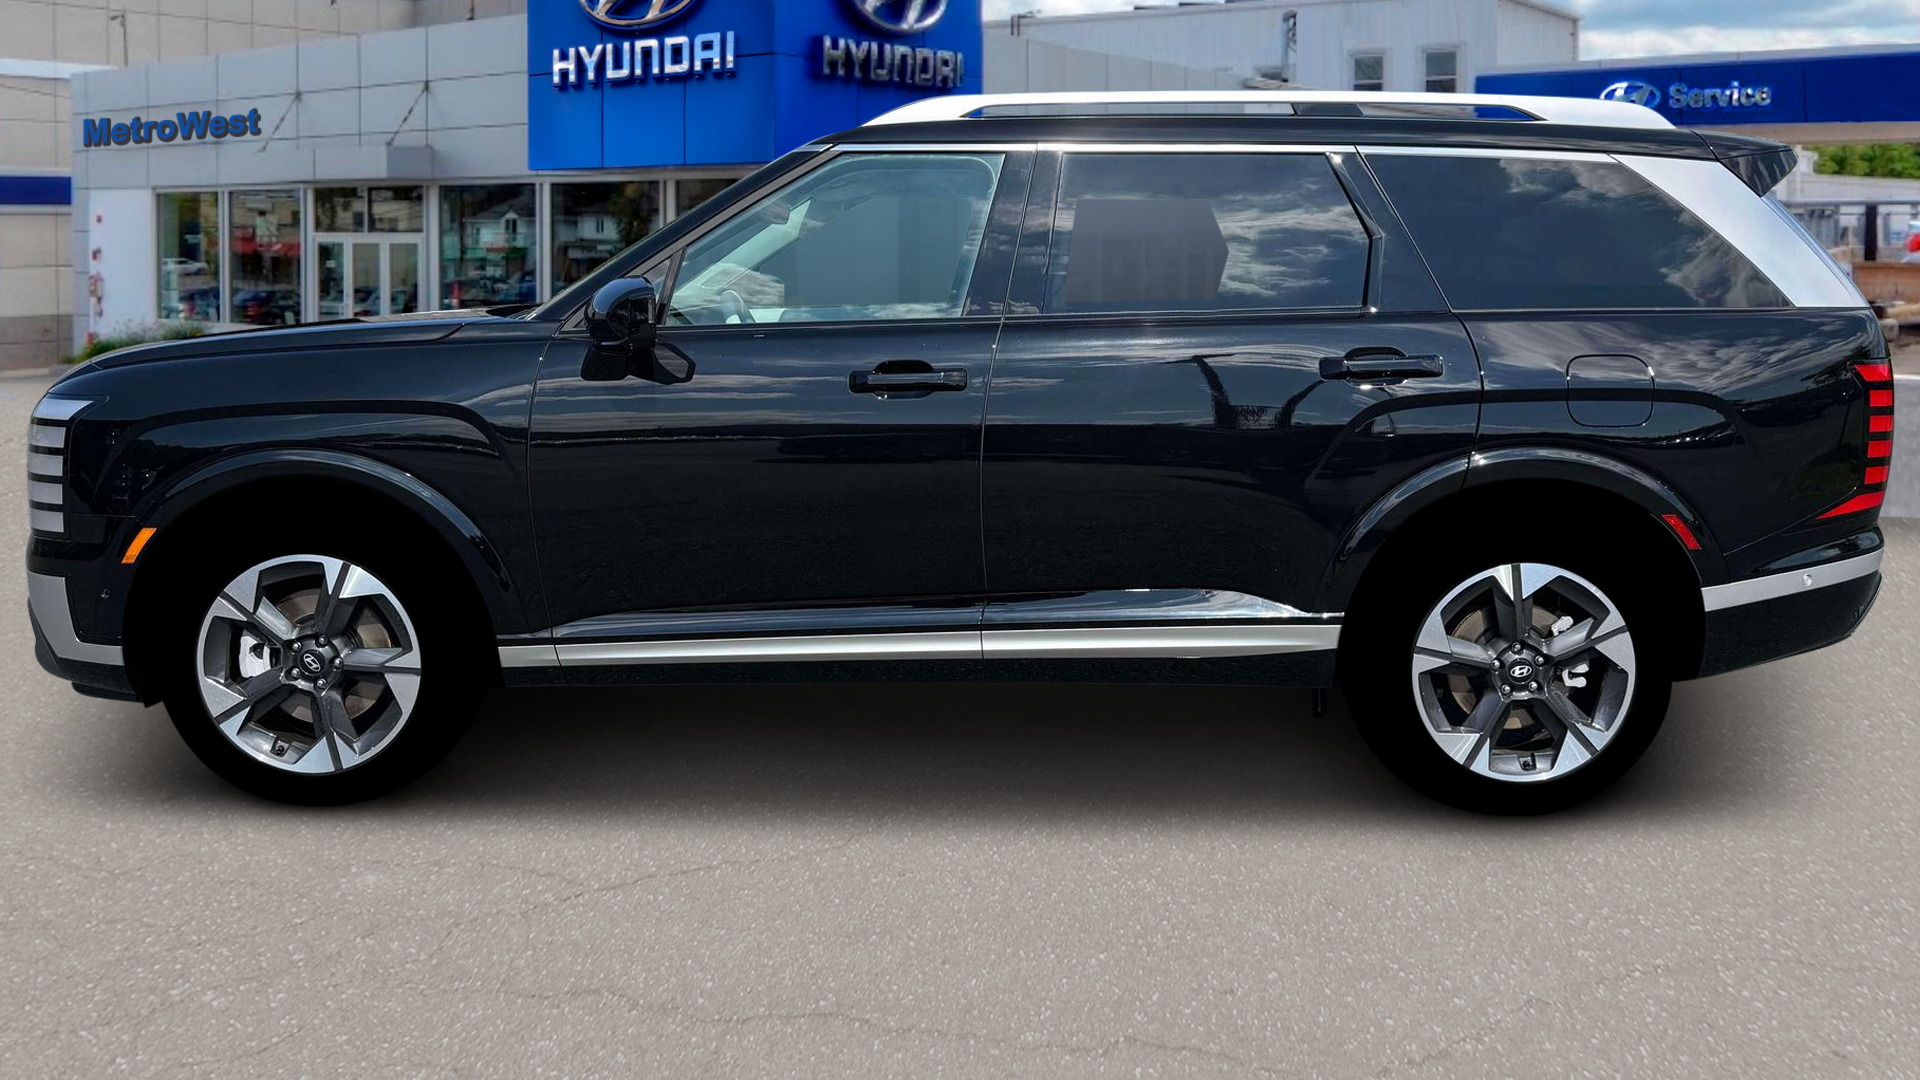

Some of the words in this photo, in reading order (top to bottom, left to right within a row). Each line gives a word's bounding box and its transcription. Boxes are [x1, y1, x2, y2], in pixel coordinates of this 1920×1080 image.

[552, 31, 735, 86] HYUNDAI
[823, 34, 965, 88] HYUNDAI
[1669, 81, 1771, 109] Service
[83, 107, 262, 148] MetroWest
